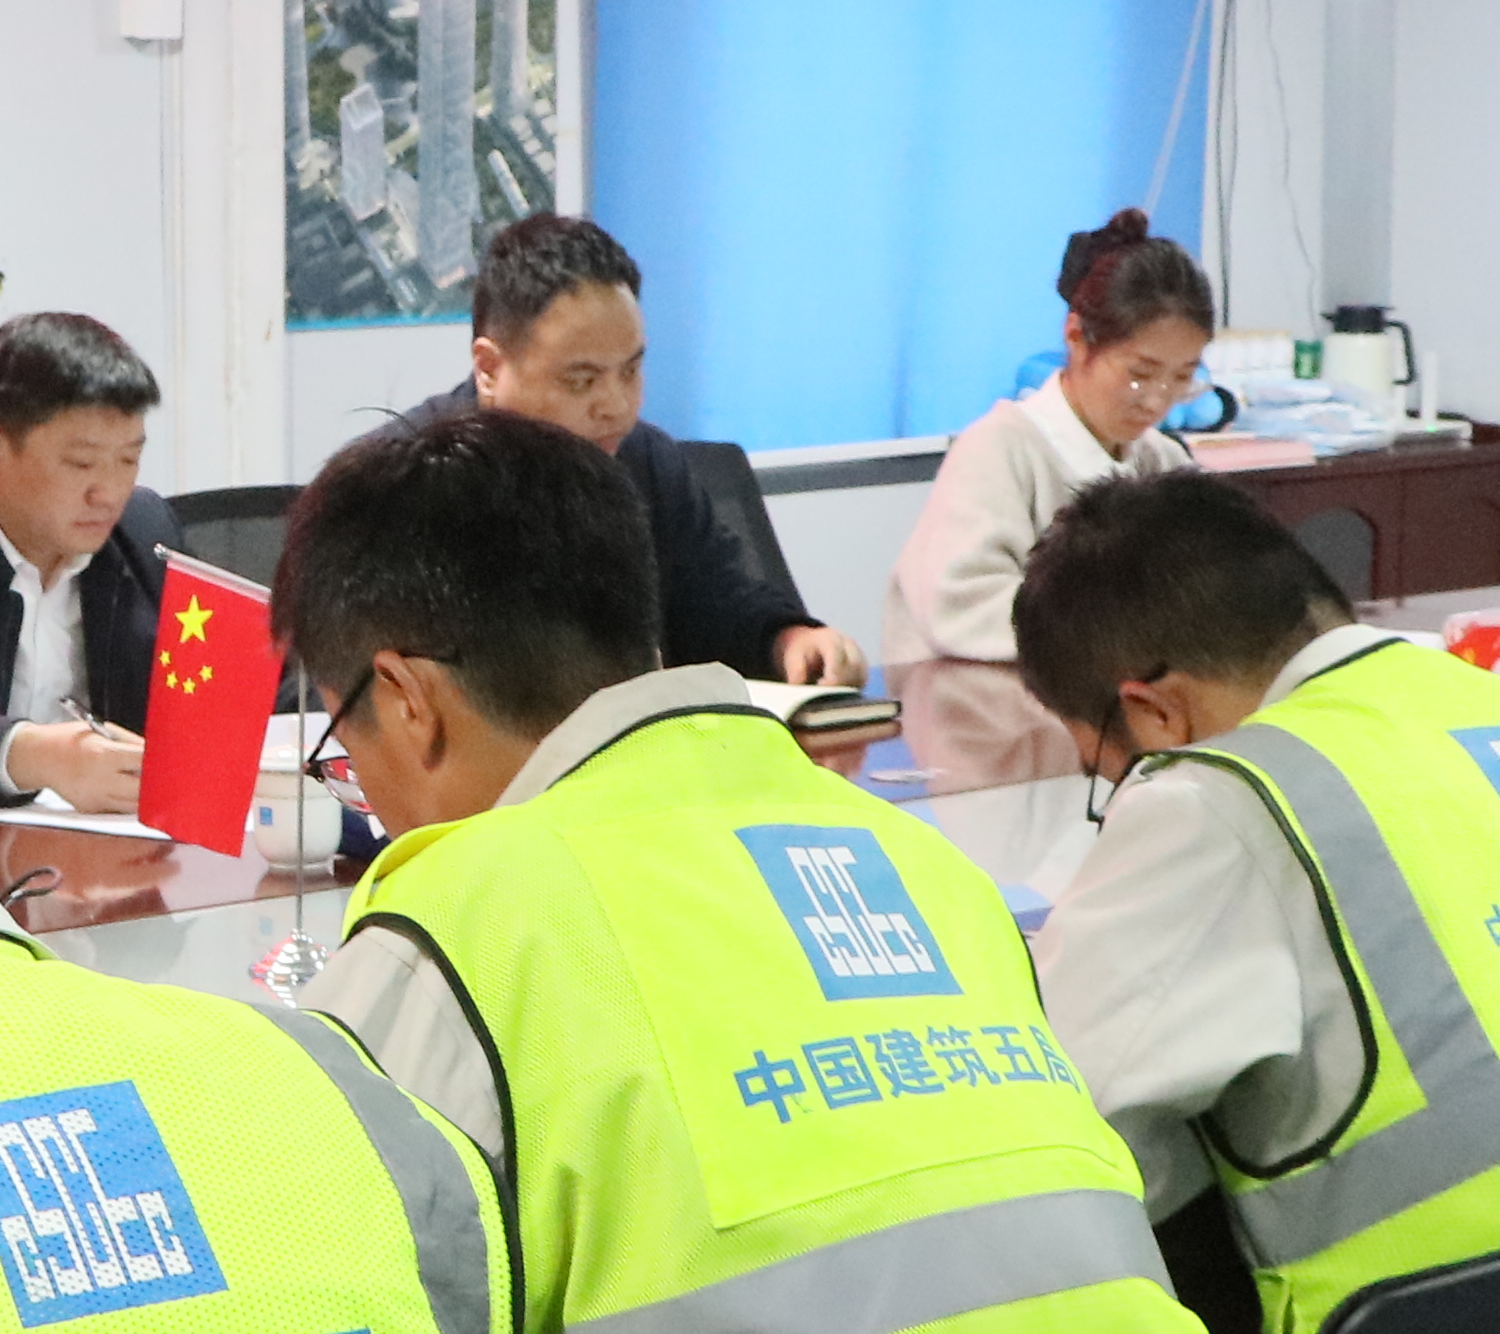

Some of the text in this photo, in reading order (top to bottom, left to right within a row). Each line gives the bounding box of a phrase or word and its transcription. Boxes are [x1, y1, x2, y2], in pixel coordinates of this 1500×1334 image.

[732, 1025, 1081, 1124] 中国建筑五局
